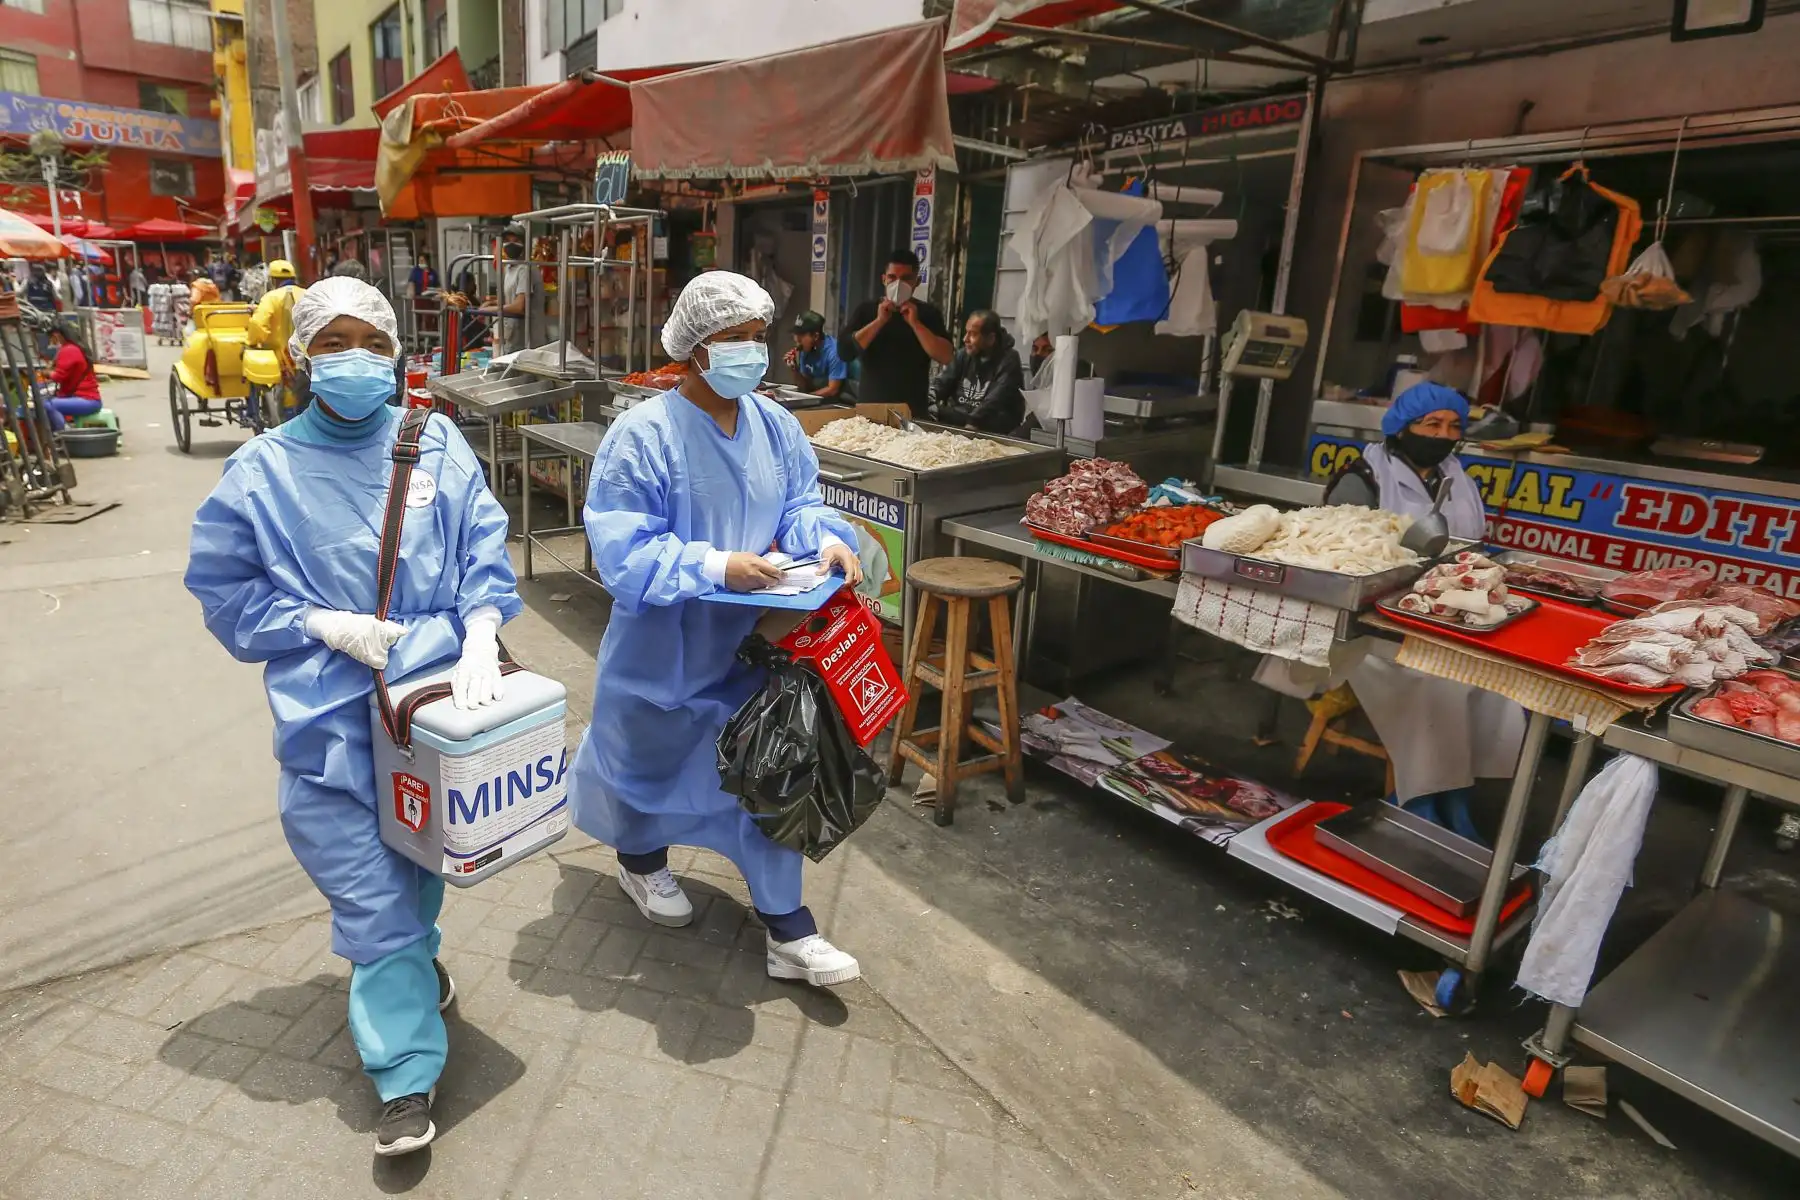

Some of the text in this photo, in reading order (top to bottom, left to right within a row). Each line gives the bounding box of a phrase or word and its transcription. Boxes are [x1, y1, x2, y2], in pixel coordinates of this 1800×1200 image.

[64, 120, 184, 151] JULIA
[1111, 121, 1188, 149] PAVITA
[410, 479, 434, 491] NSA
[1311, 441, 1584, 521] COCIAL
[1484, 519, 1595, 560] ACIONAL
[1604, 543, 1626, 566] E
[821, 632, 857, 671] Deslab
[857, 622, 868, 636] 5L
[401, 776, 424, 793] ¡PARE!
